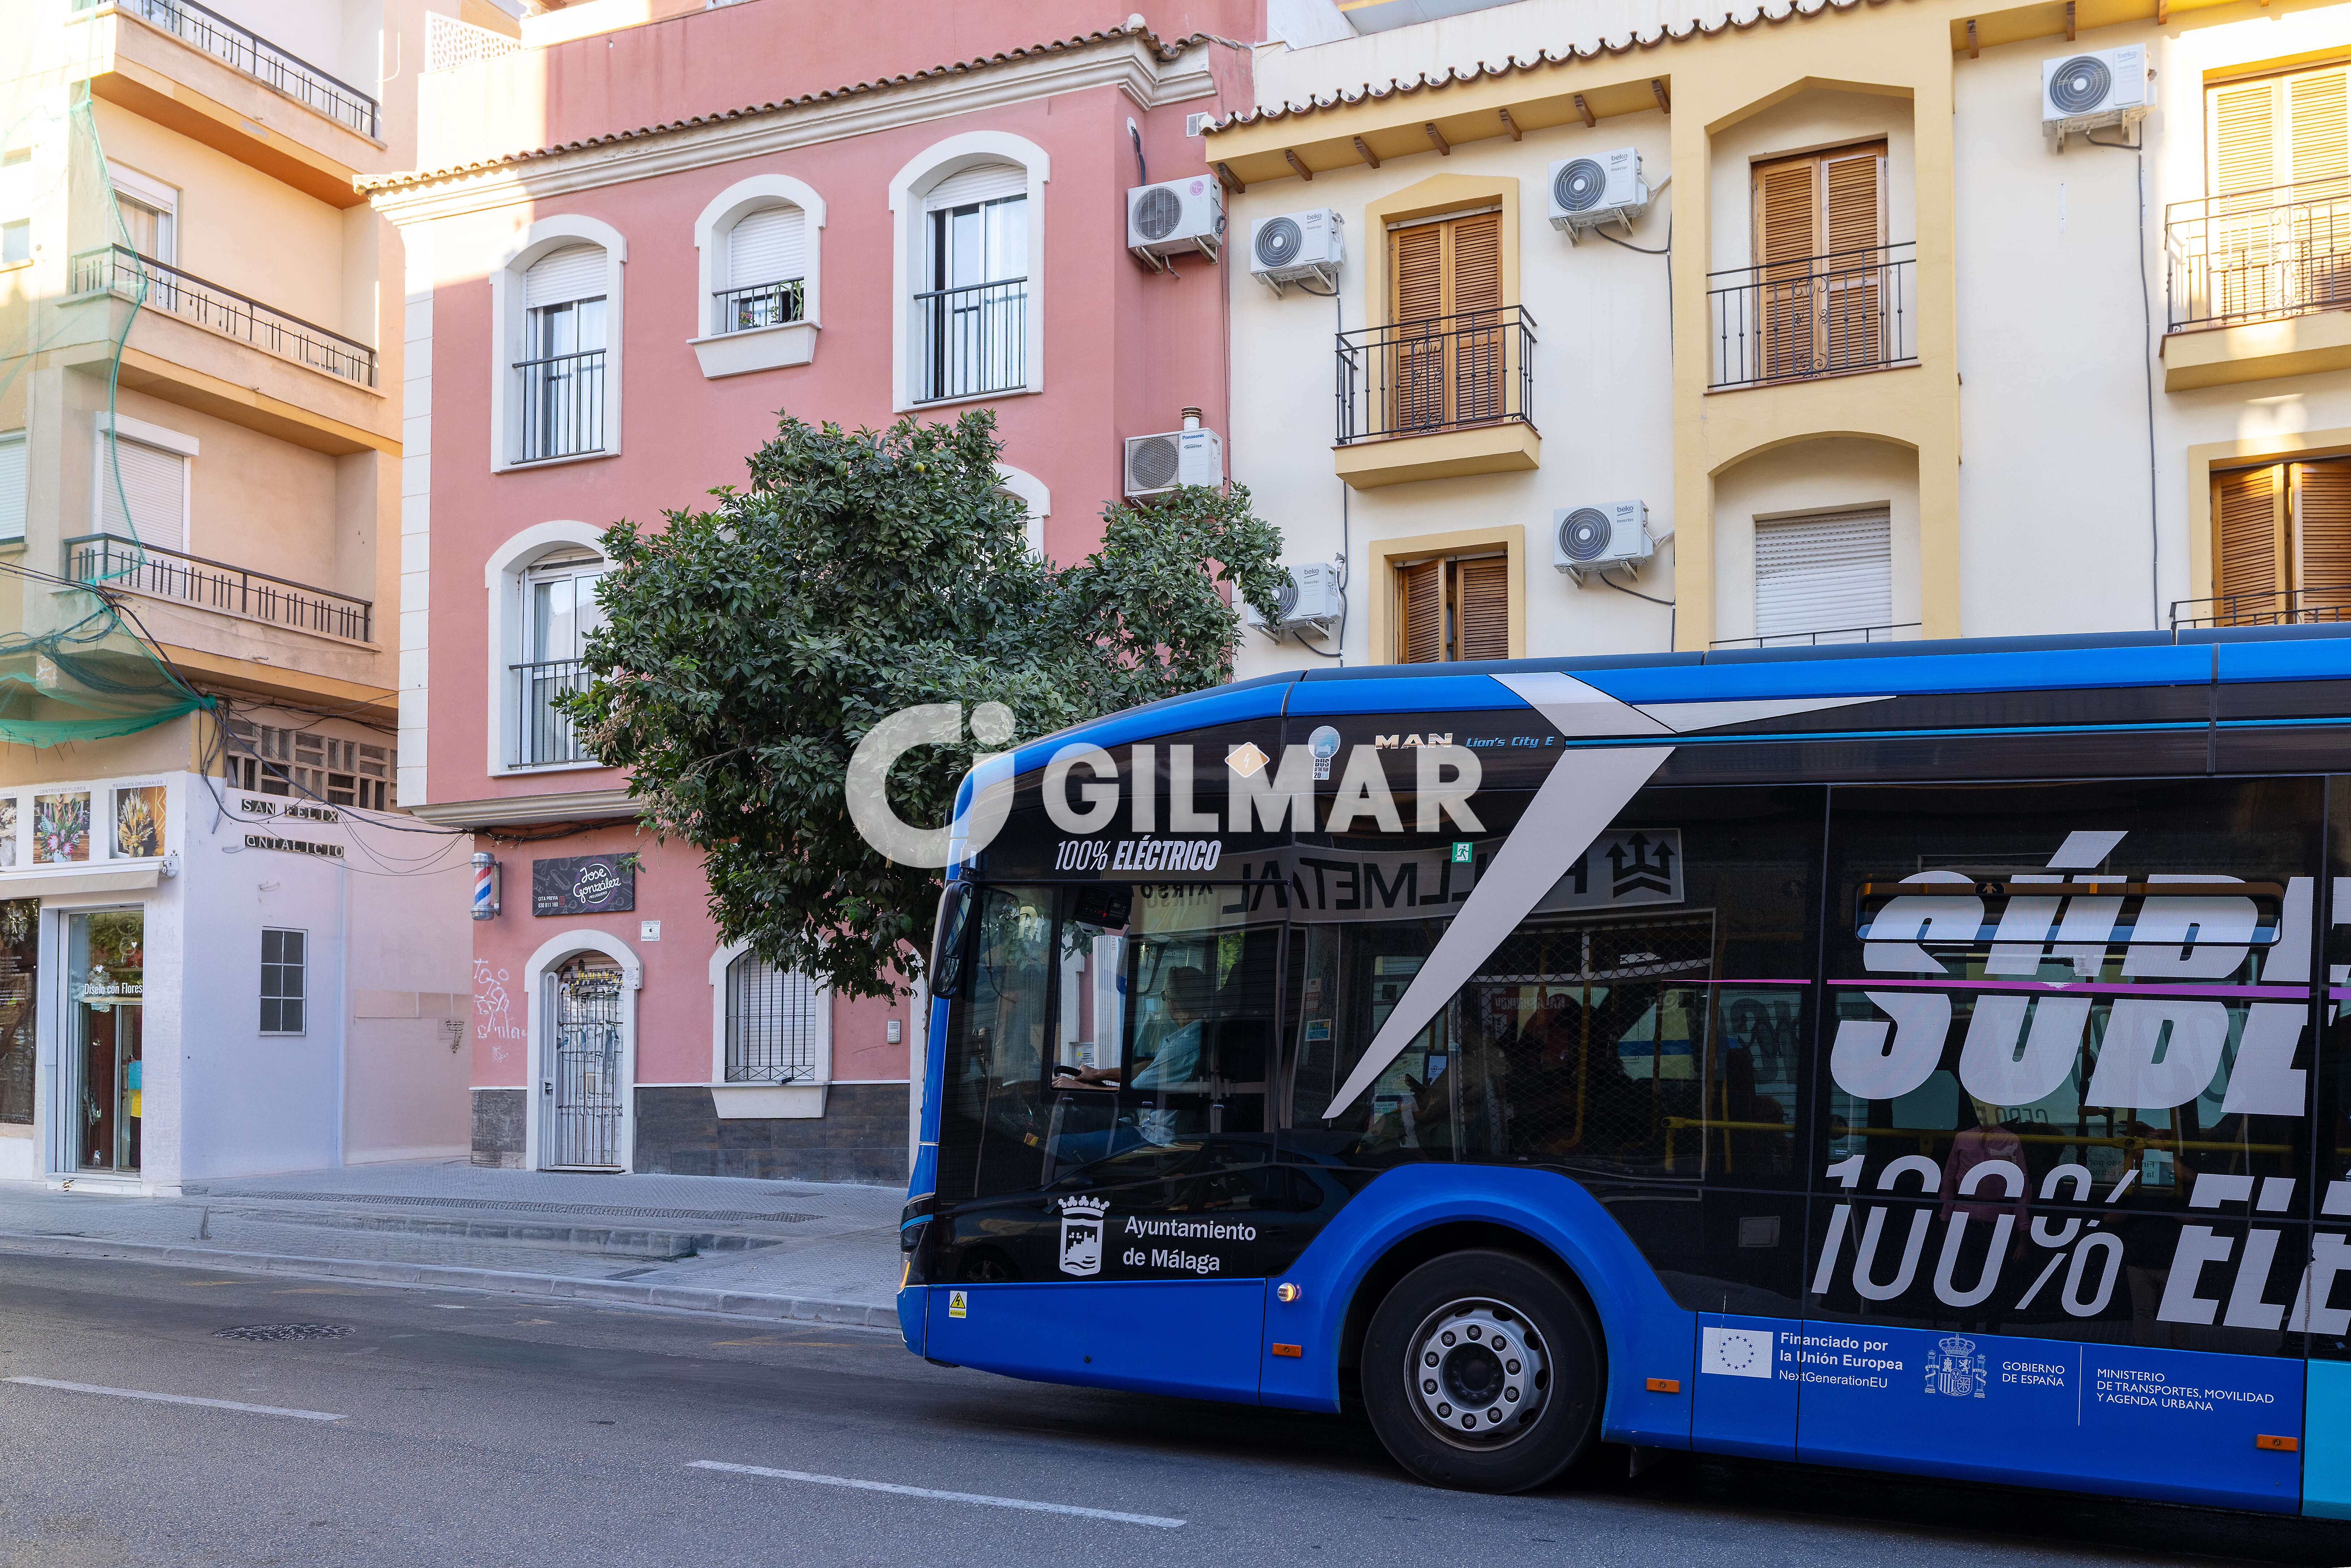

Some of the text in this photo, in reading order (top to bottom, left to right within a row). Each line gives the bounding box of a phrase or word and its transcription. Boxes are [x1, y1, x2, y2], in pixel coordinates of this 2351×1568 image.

[1376, 733, 1453, 749] MAN
[1466, 736, 1555, 748] Lion's City E
[243, 799, 338, 822] SAN FELIX
[1056, 835, 1222, 871] 100% ELÉCTRICO
[579, 867, 607, 883] Jose
[573, 877, 621, 904] González
[589, 891, 607, 900] PELUQUERO
[82, 983, 105, 997] ¡Díselo
[122, 982, 143, 994] Flores
[1125, 1215, 1256, 1241] Ayuntamiento
[1812, 1155, 2140, 1317] 100%
[1123, 1248, 1220, 1274] de Málaga
[1780, 1332, 1888, 1353] Financiado por
[1780, 1348, 1903, 1372] la Unión Europea
[2003, 1361, 2065, 1375] GOBIERNO
[1779, 1369, 1888, 1389] NextGenerationEU
[2003, 1373, 2064, 1387] DE ESPAÑA
[2097, 1368, 2165, 1383] MINISTERIO
[2097, 1381, 2274, 1403] DE TRANSPORTES, MOVILIDAD
[2097, 1393, 2213, 1411] Y AGENDA URBANA
